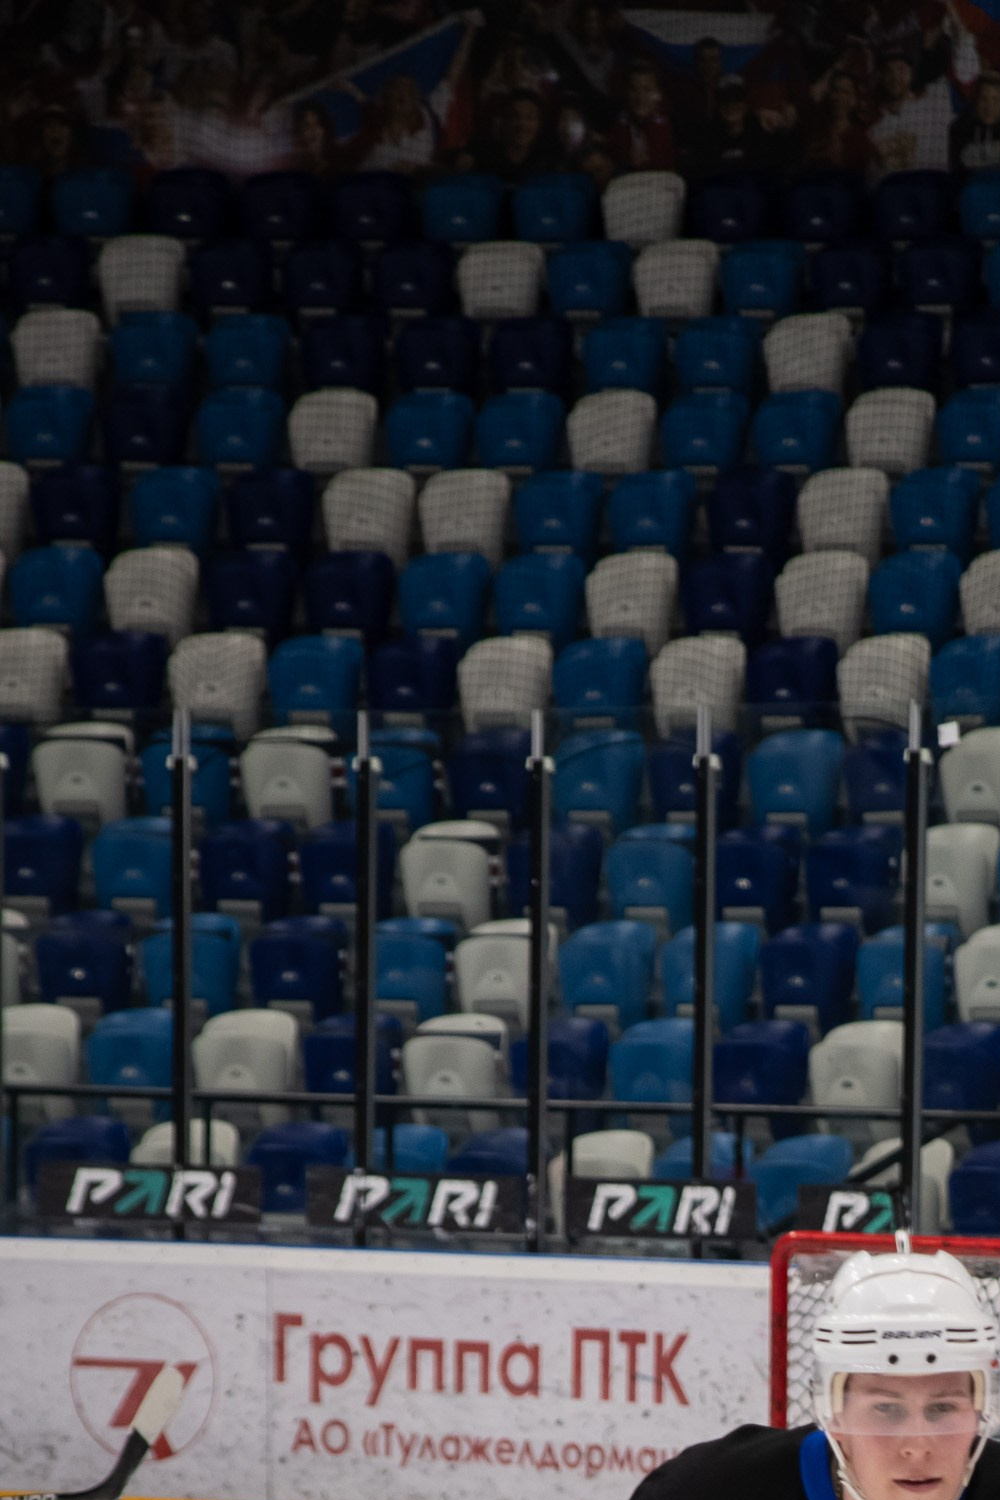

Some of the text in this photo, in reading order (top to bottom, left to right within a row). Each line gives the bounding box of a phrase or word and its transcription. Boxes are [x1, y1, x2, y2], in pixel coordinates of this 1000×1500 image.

[65, 1166, 237, 1218] PARI
[333, 1174, 498, 1229] PARI
[586, 1183, 737, 1236] PARI
[821, 1191, 897, 1233] PA
[272, 1312, 689, 1407] Группа ПТК
[291, 1418, 350, 1456] АО
